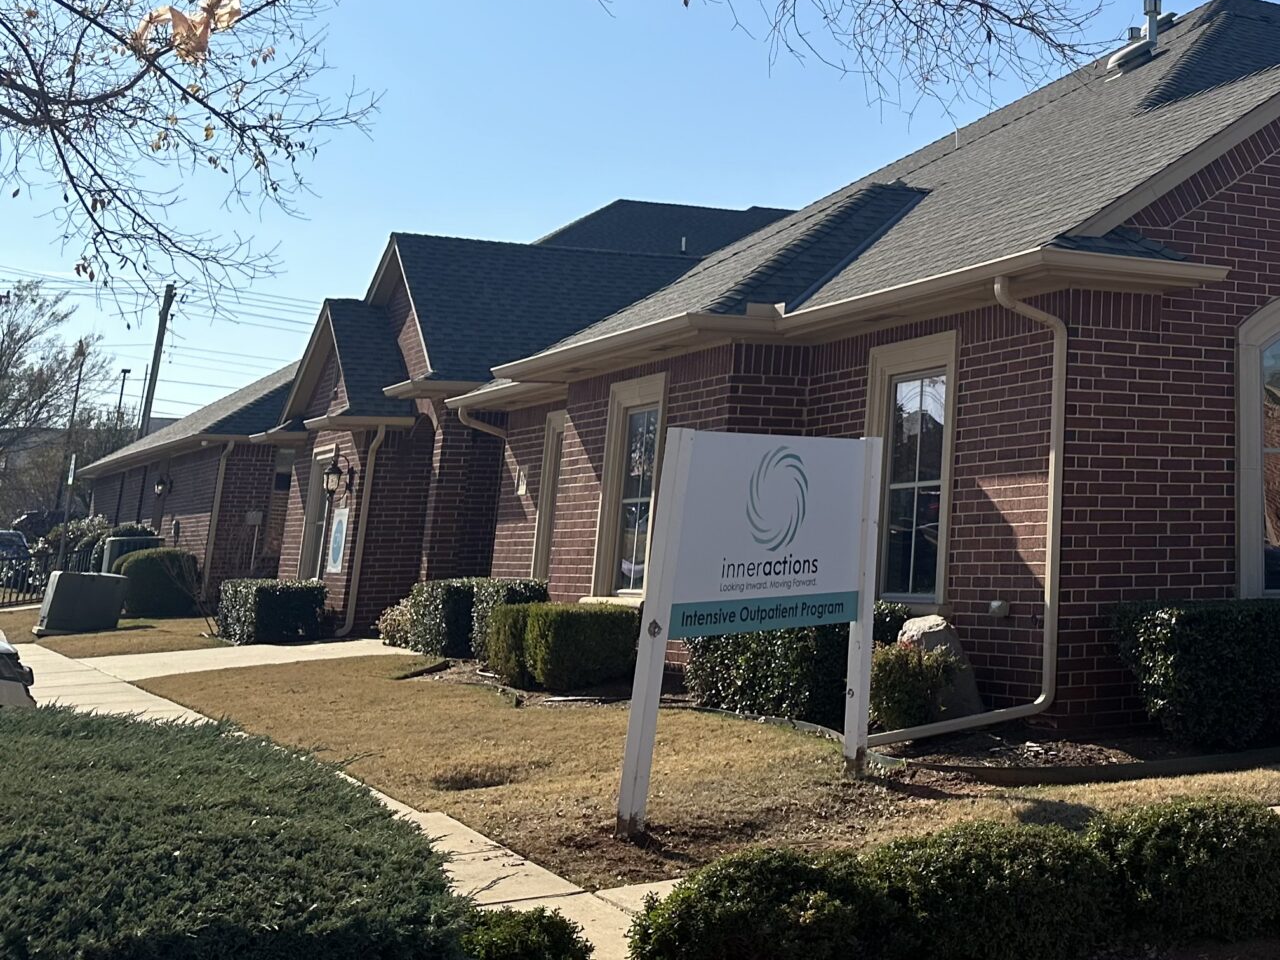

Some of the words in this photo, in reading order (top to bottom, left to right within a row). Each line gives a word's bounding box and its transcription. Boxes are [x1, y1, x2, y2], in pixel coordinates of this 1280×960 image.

[721, 554, 819, 578] inneractions
[720, 582, 745, 592] Looking
[769, 580, 792, 590] Moving
[681, 607, 736, 627] Intensive
[740, 602, 798, 624] Outpatient
[801, 601, 844, 619] Program
